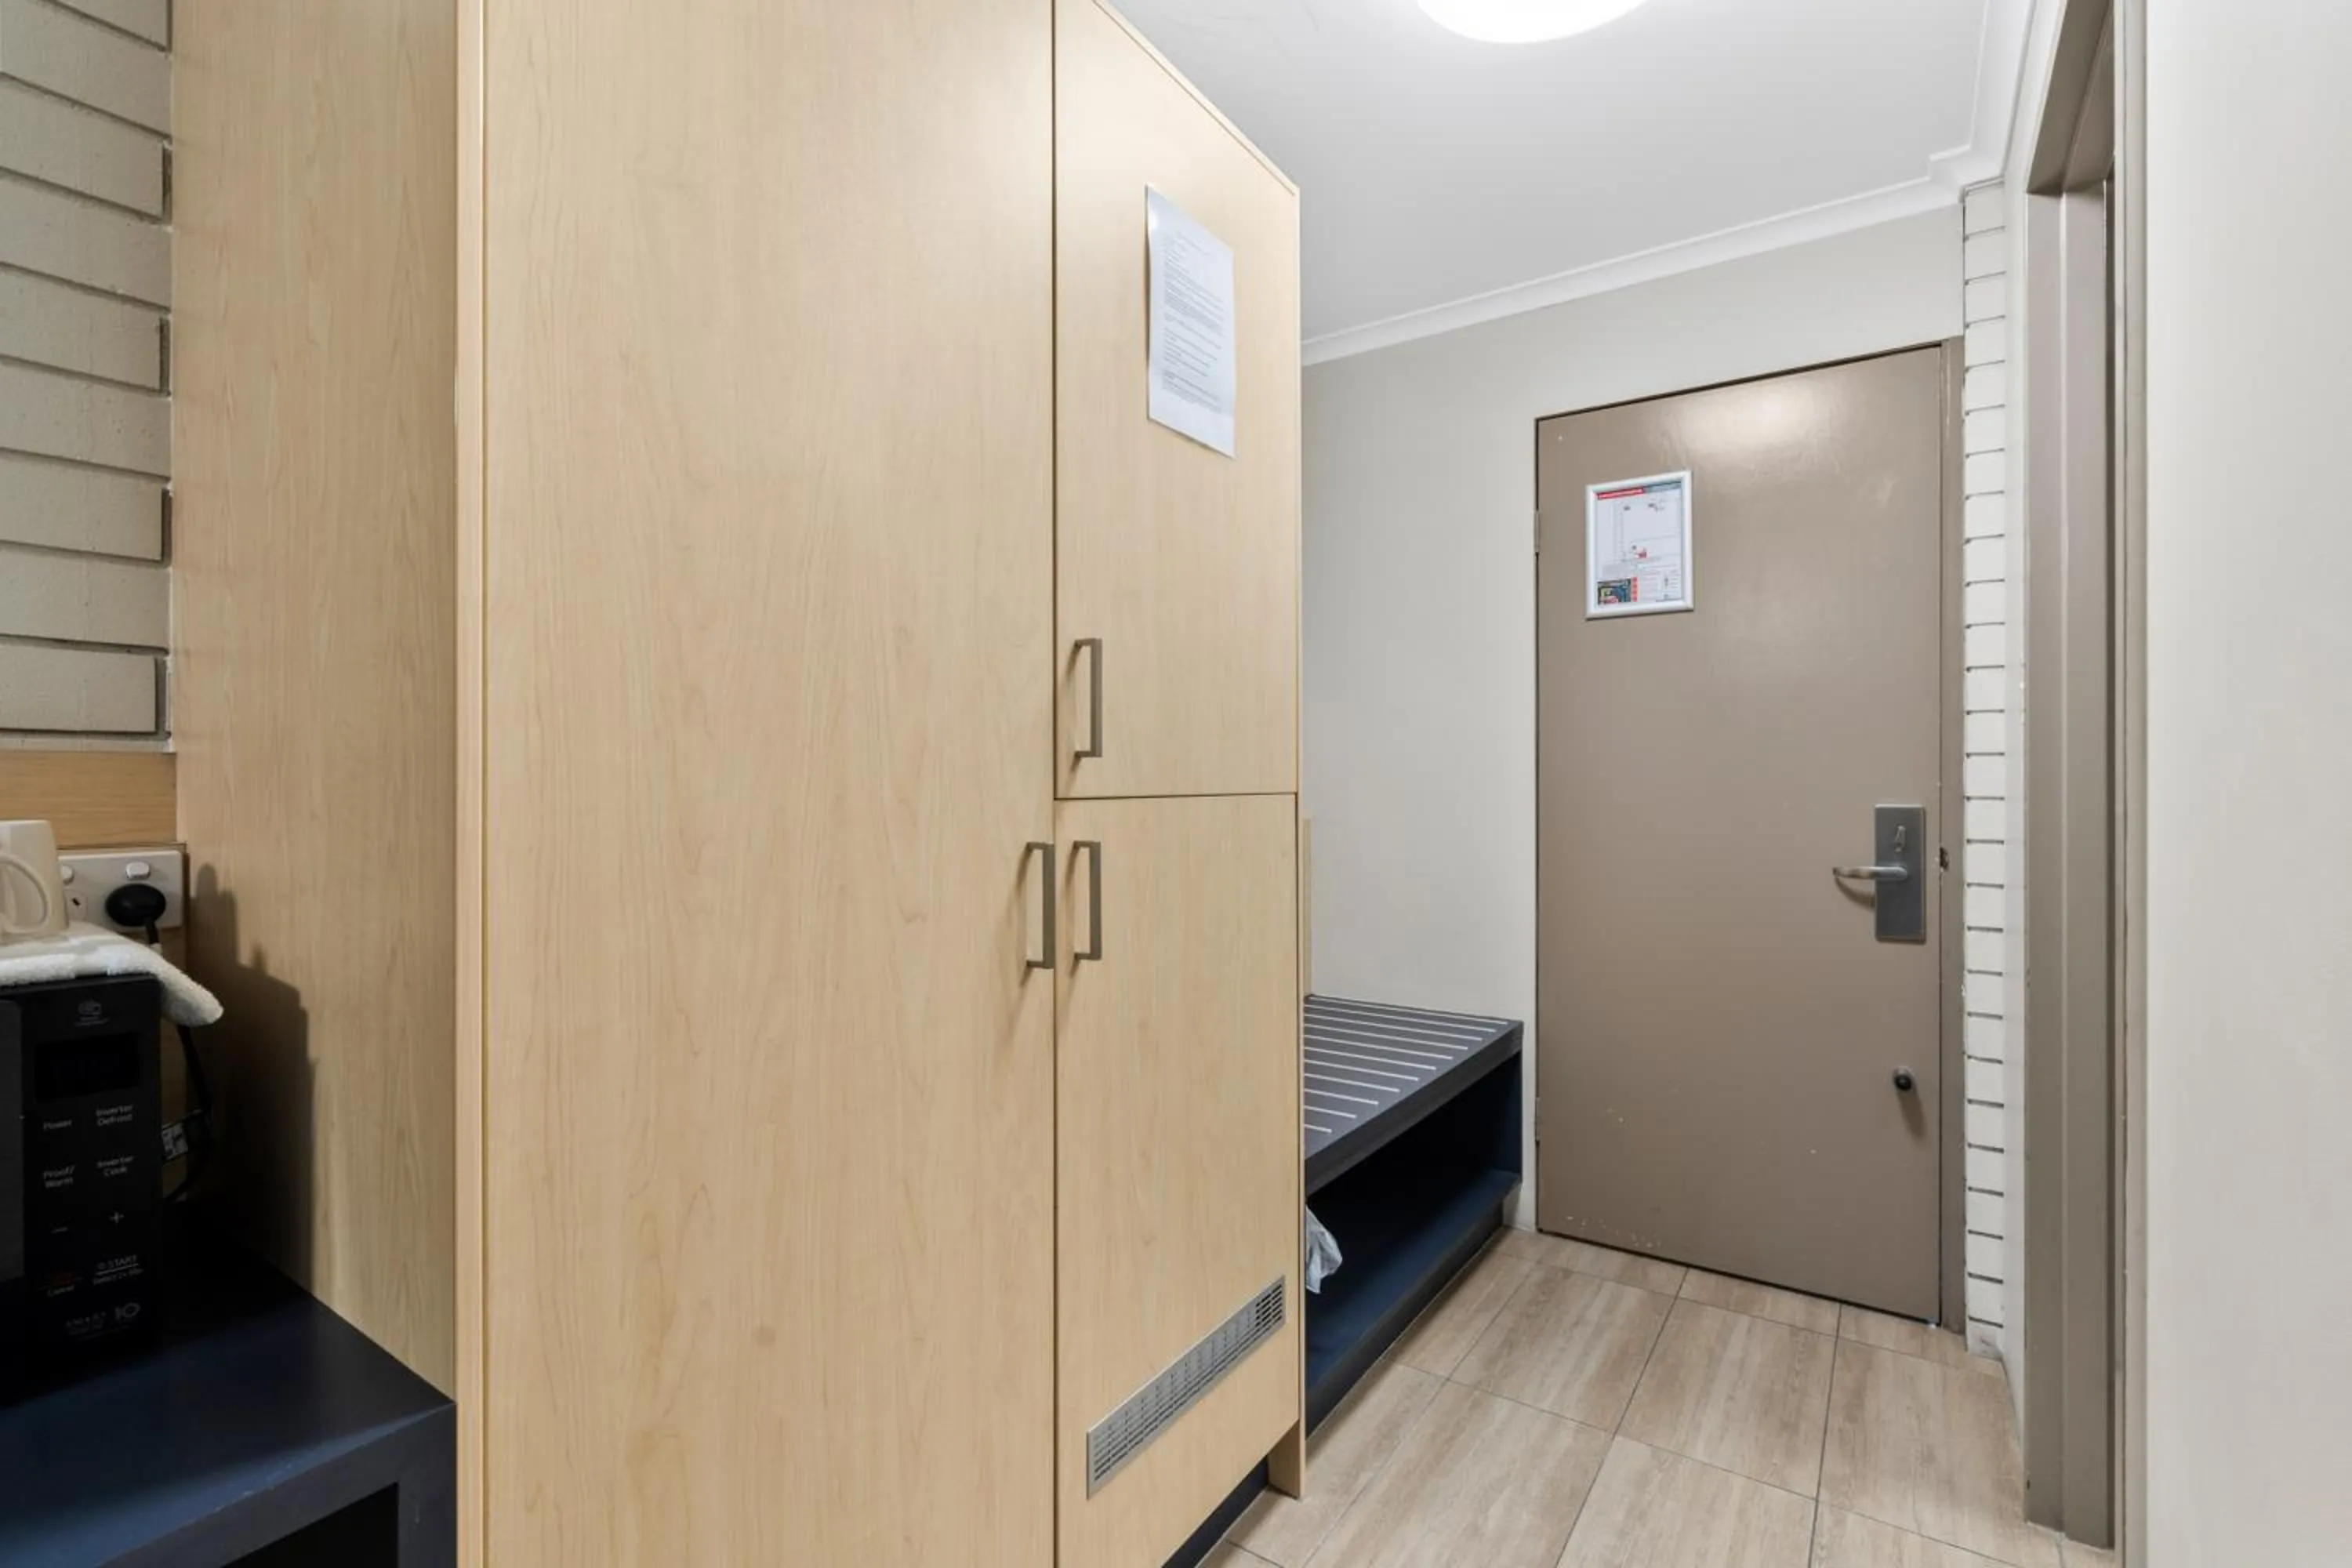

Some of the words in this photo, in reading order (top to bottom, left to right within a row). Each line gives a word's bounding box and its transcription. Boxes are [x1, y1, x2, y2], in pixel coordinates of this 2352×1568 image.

[96, 1104, 133, 1116] Inverter
[43, 1120, 73, 1131] Power
[96, 1113, 133, 1127] Defrost
[103, 1166, 128, 1177] Cook
[44, 1177, 74, 1190] Warm
[107, 1254, 138, 1269] START
